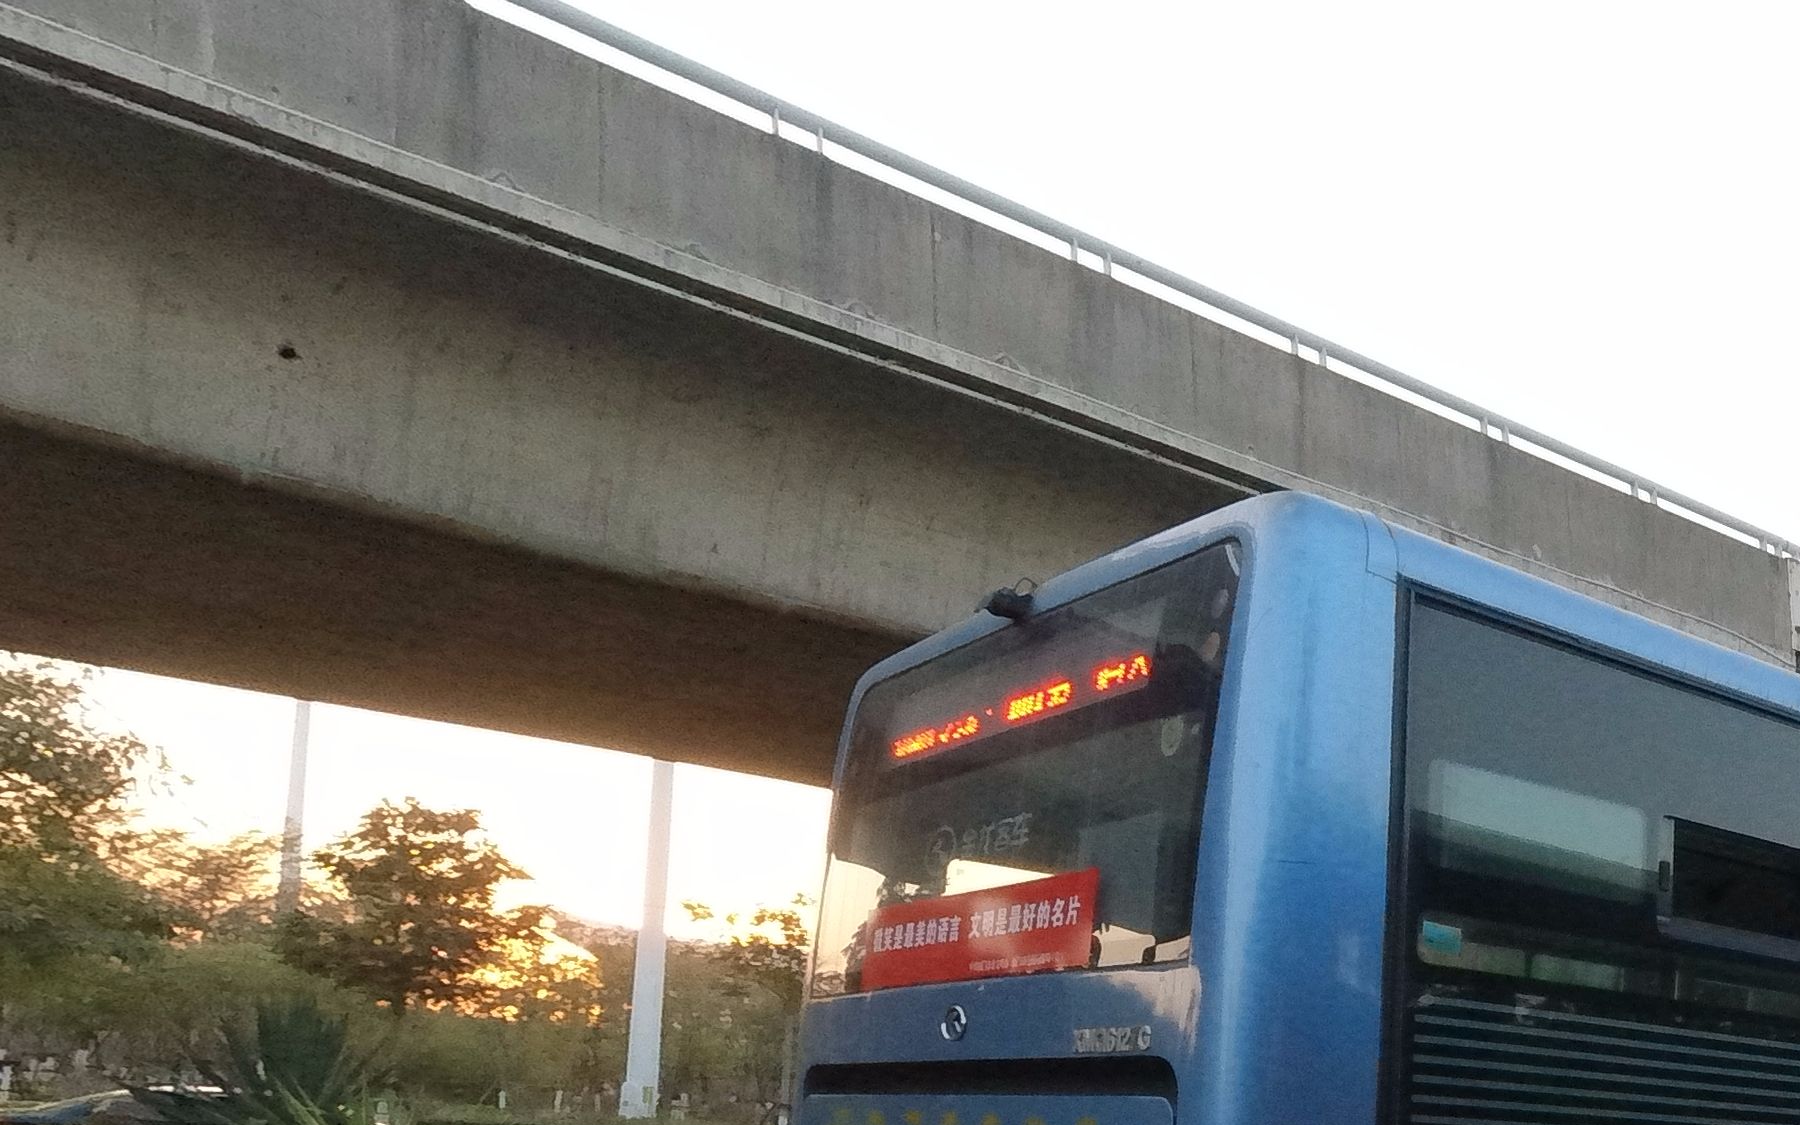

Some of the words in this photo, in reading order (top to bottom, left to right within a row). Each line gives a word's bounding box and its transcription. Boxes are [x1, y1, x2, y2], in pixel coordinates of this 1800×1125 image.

[873, 914, 963, 953] 微笑是最美的语言
[968, 895, 1081, 939] 文明是最好的名片
